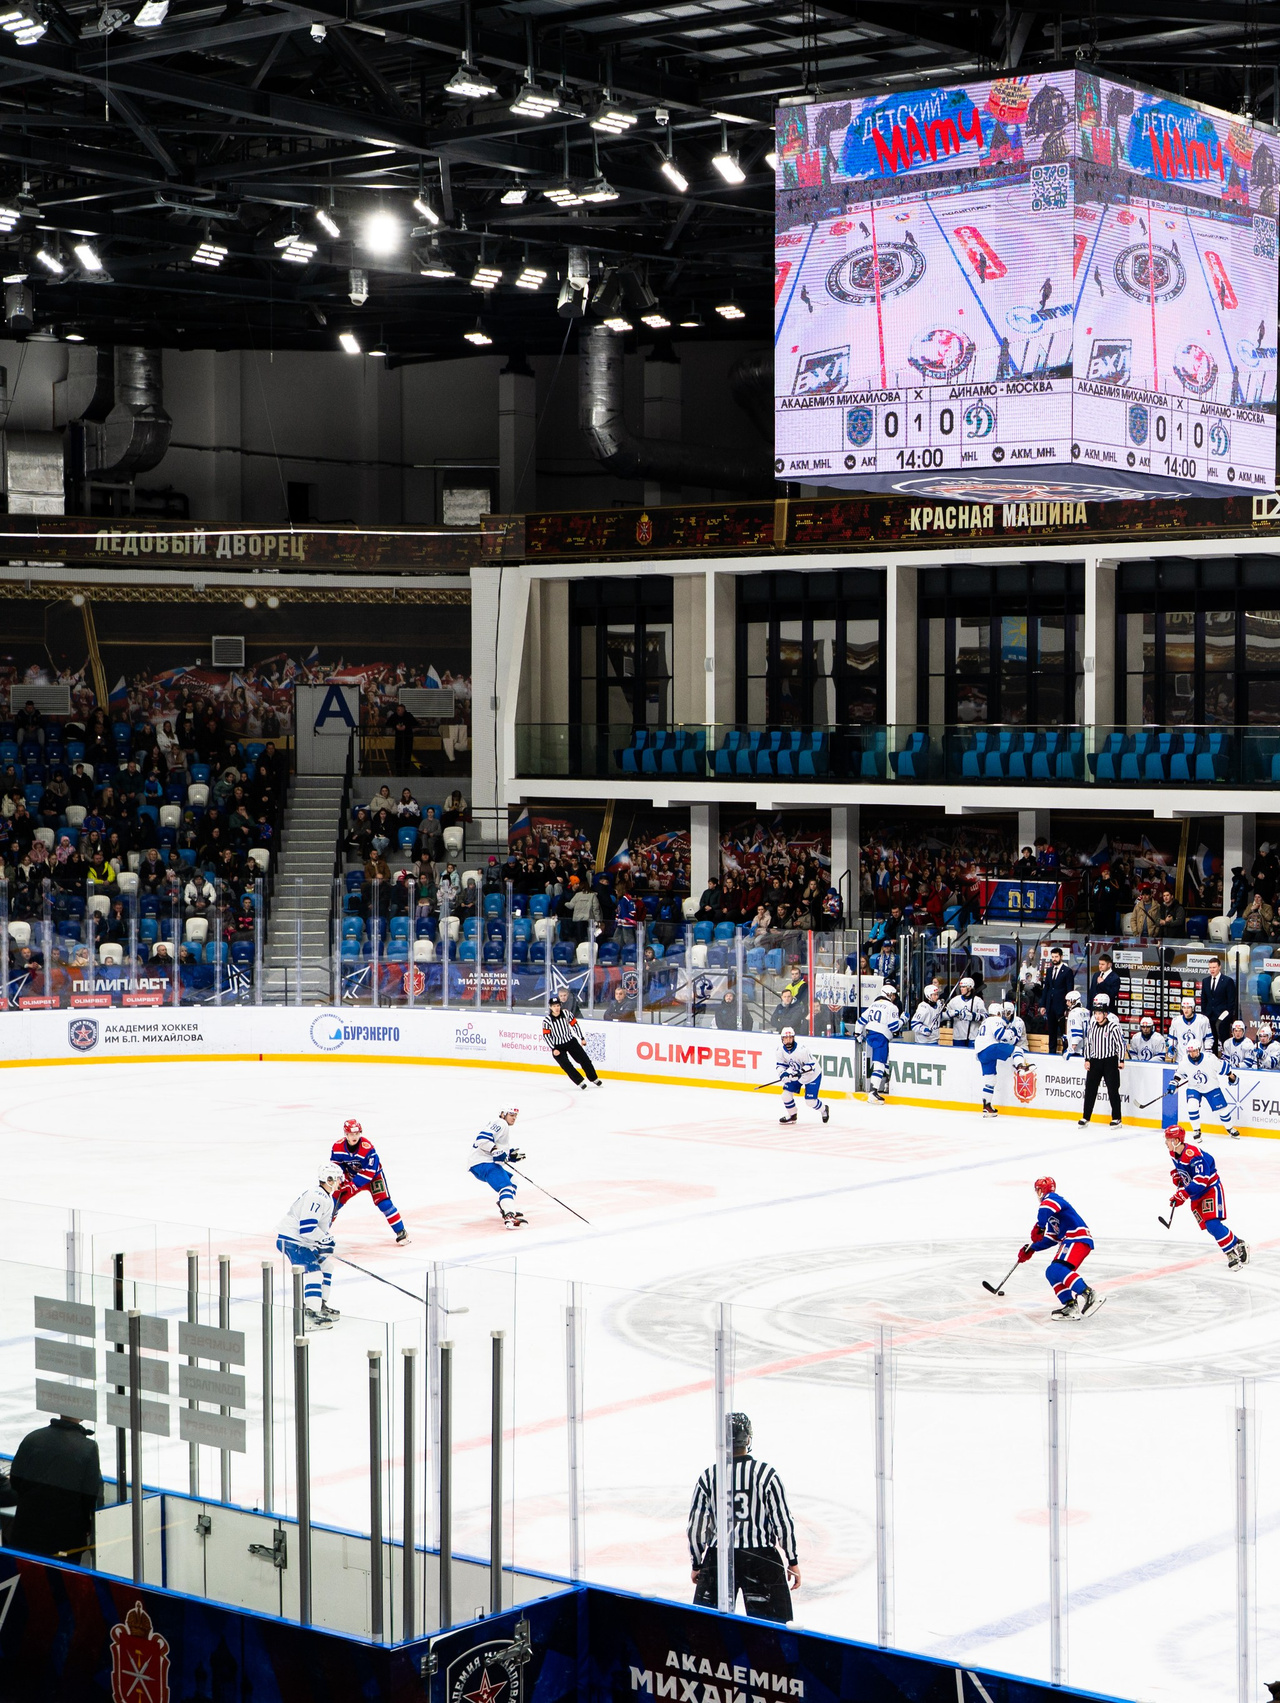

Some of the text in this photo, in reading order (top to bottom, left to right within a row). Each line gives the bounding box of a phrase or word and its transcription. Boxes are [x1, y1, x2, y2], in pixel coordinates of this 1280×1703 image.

[781, 391, 901, 409] АКАДЕМИЯ МИХАЙЛОВА
[949, 382, 1053, 400] ДИНАМО МОСКВА
[1078, 383, 1168, 408] АКАДЕМИЯ МИХАЙЛОВА
[914, 414, 922, 432] 1
[940, 408, 954, 436] 0
[1200, 404, 1265, 424] ДИНАМО МОСКВА
[885, 411, 898, 438] 0
[1156, 416, 1167, 442] 0
[1176, 423, 1183, 441] 1
[1194, 422, 1203, 449] 0
[896, 448, 944, 469] 14:00
[1164, 456, 1197, 479] 14:00
[910, 501, 1088, 531] КРАСНАЯ МАШИНА
[95, 528, 305, 561] ЛЕДОВЫЙ ДВОРЕЦ
[315, 683, 357, 727] А
[1008, 888, 1037, 913] DJ
[973, 946, 998, 954] OLIMPBET
[73, 978, 170, 993] ПОЛИПЛАСТ
[126, 996, 160, 1004] OLIMPBET
[104, 1033, 204, 1044] ИМ Б.П. МИХАЙЛОВА
[105, 1024, 199, 1033] АКАДЕМИЯ ХОККЕЯ
[343, 1026, 400, 1042] БУРЭНЕРГО
[498, 1030, 532, 1040] Квартиры
[501, 1042, 532, 1051] мебелью
[636, 1041, 763, 1070] OLIMPBET
[310, 1202, 321, 1213] 17
[665, 1650, 805, 1699] АКАДЕМИЯ
